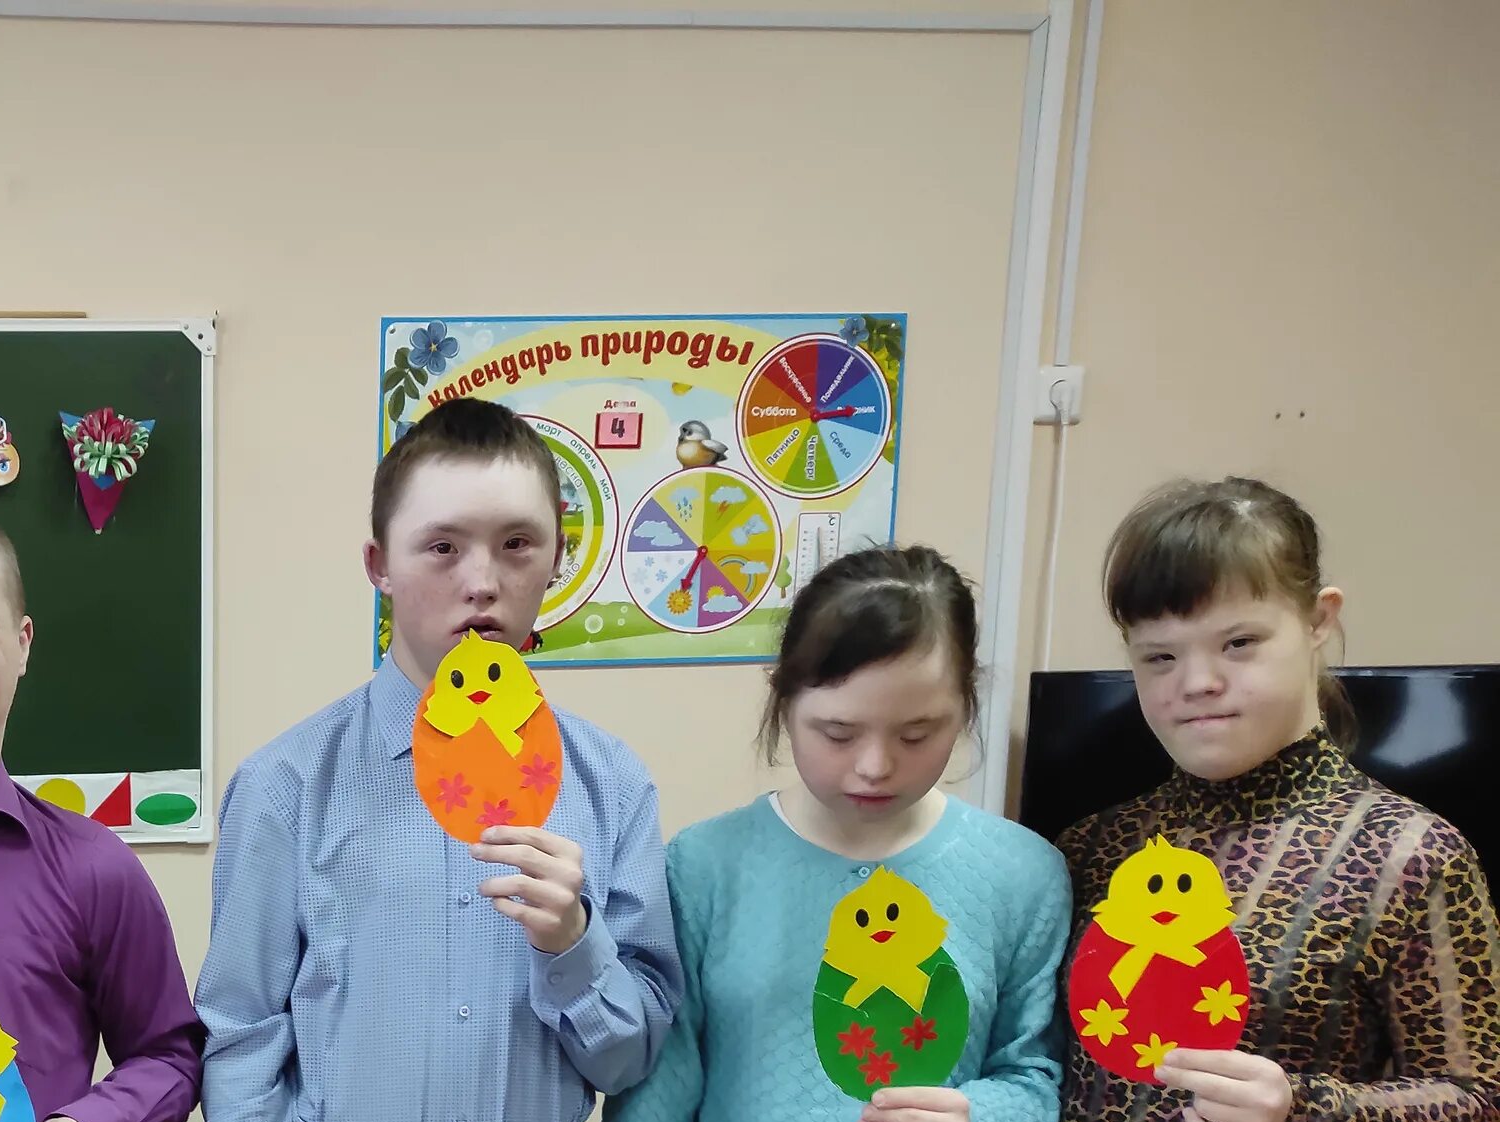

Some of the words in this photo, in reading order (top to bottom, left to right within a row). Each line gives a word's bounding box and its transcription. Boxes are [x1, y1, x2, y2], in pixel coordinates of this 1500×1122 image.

[581, 330, 754, 369] природы
[750, 406, 797, 418] Суббота
[536, 422, 562, 438] март
[610, 417, 626, 439] 4
[569, 439, 599, 470] апрель
[765, 428, 801, 466] Пятница
[829, 431, 852, 459] Среда
[599, 478, 612, 501] май
